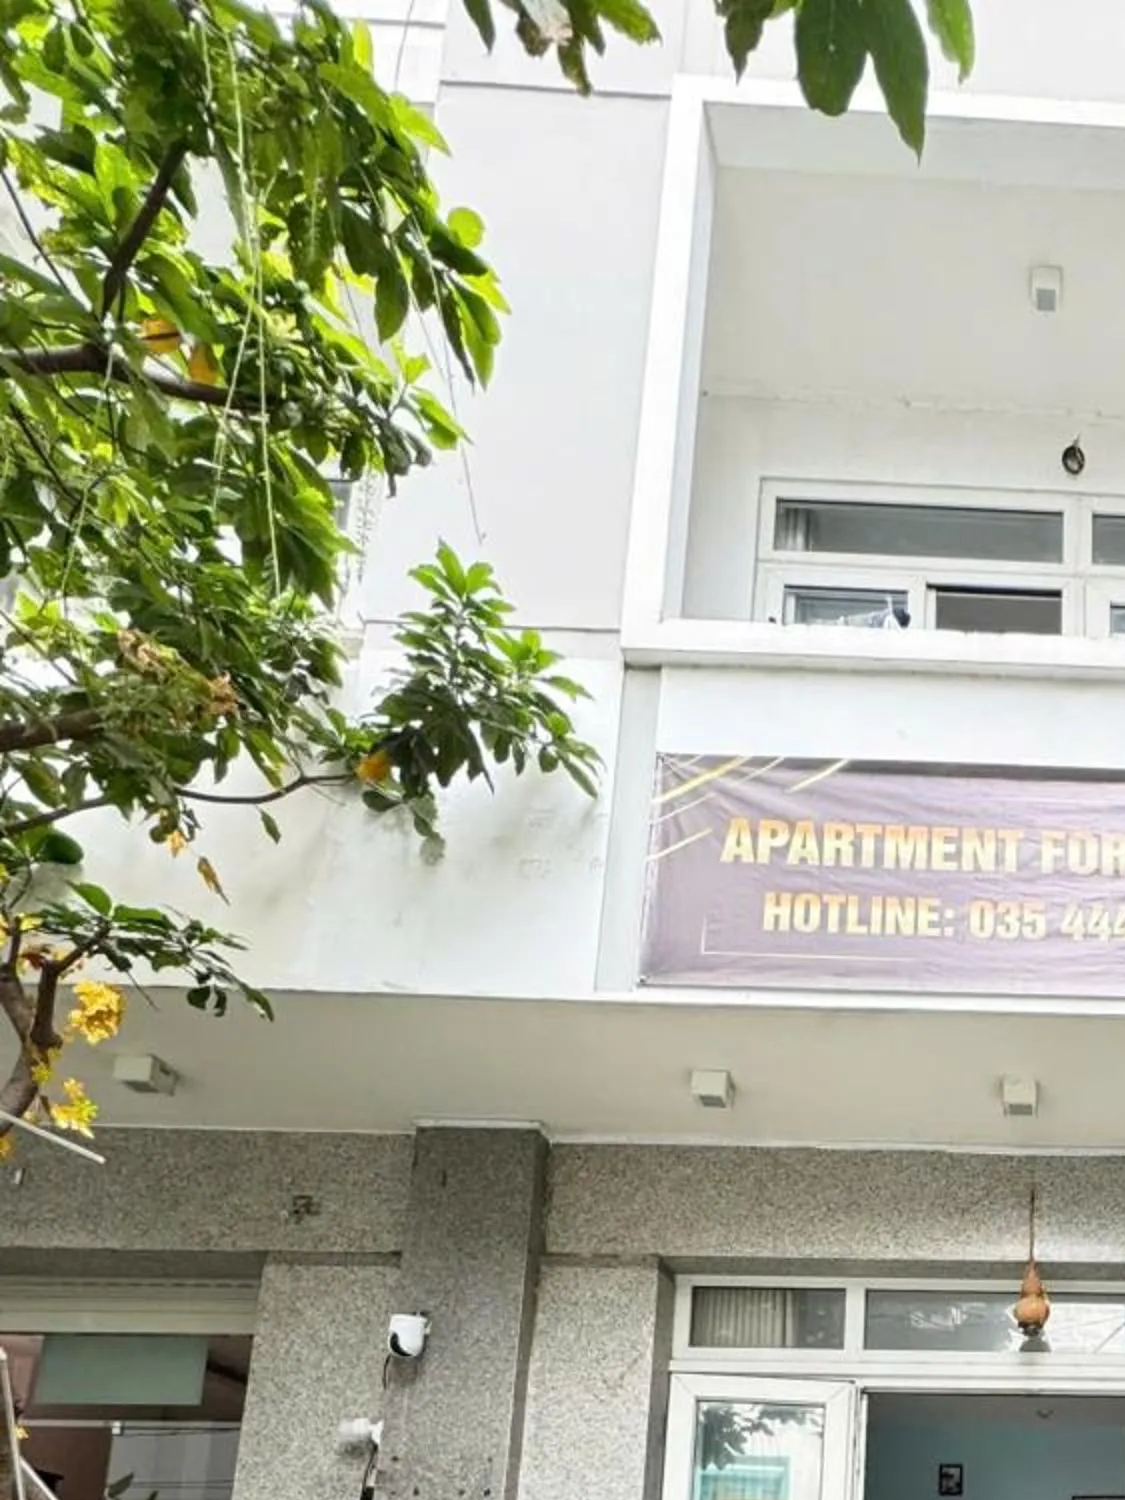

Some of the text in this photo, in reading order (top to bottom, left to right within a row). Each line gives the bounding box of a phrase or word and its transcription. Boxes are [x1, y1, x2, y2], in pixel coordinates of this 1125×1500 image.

[719, 817, 1025, 874] APARTMENT
[762, 891, 955, 938] HOTLINE:
[968, 898, 1047, 941] 035
